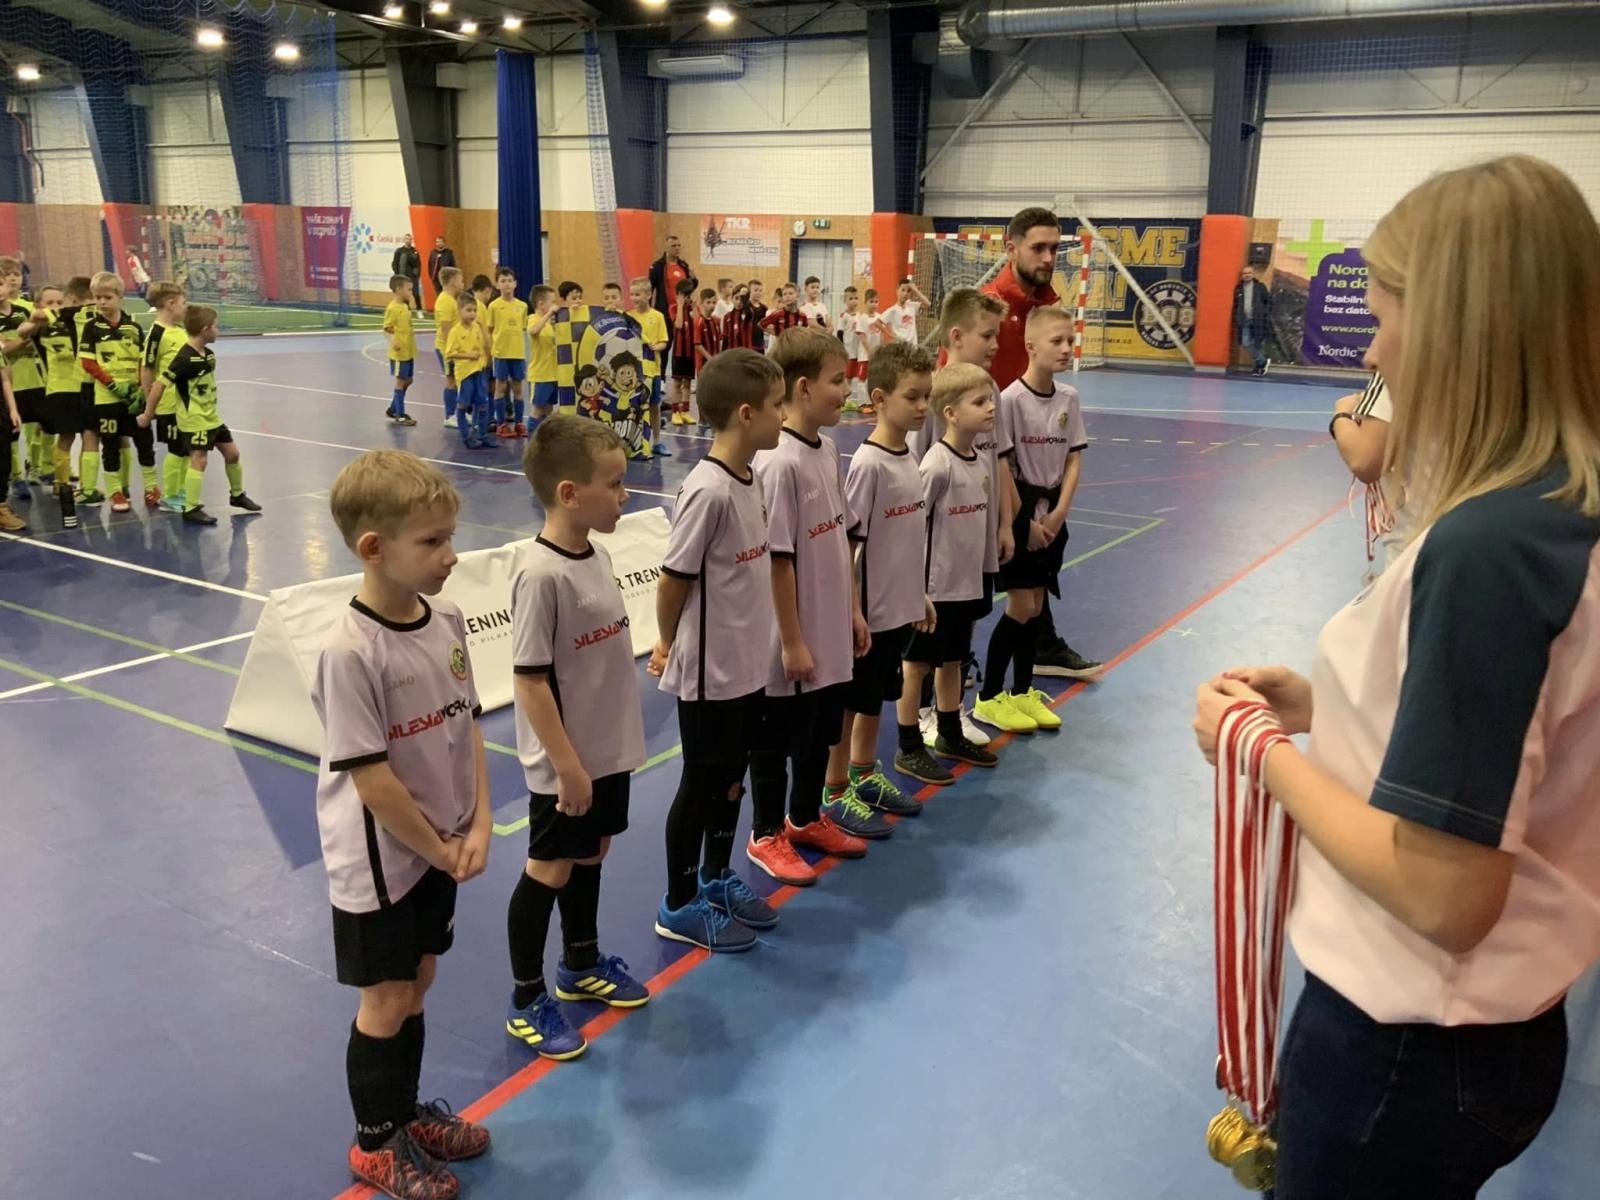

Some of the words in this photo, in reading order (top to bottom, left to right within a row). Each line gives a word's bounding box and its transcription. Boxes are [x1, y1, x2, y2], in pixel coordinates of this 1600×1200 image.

[725, 217, 751, 229] TKR
[1327, 279, 1347, 289] na
[1323, 305, 1344, 314] bez
[1318, 344, 1358, 358] Nordic
[100, 419, 117, 433] 20
[167, 424, 178, 440] 11
[191, 430, 208, 445] 25
[625, 565, 663, 588] TREN
[465, 608, 513, 636] ENIN
